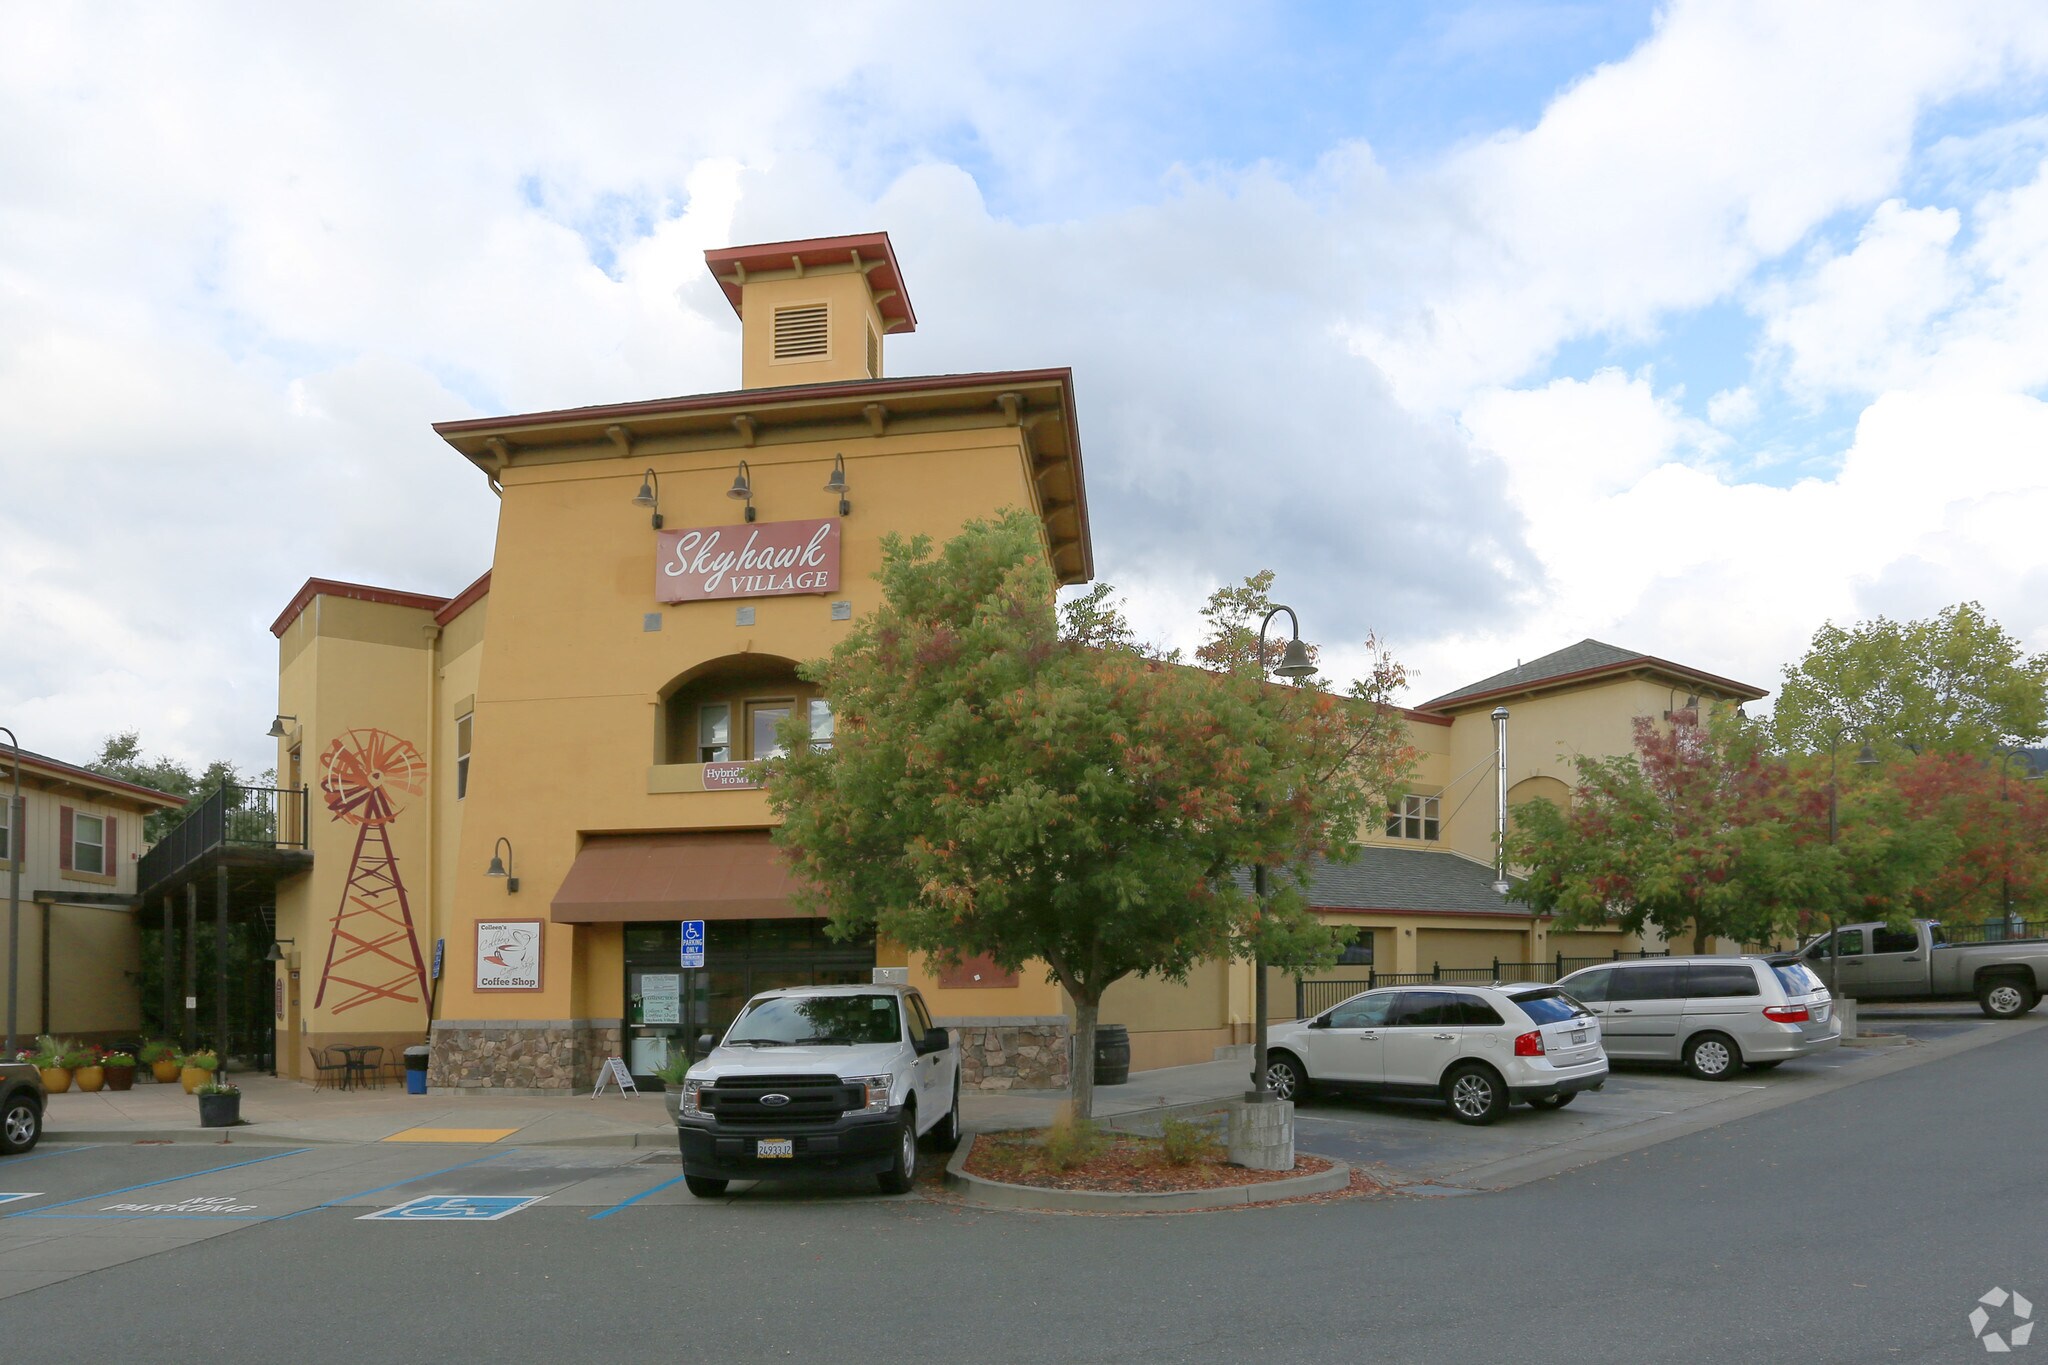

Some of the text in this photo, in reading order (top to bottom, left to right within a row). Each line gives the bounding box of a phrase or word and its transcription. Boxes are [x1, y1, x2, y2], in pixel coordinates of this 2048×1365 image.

[664, 523, 831, 593] Skyhawk
[730, 571, 829, 593] VILLAGE
[686, 946, 699, 954] ONLY
[481, 977, 536, 987] Coffee Shop
[759, 1145, 791, 1155] 24933J2
[179, 1196, 237, 1204] NO
[99, 1203, 258, 1213] PARKING
